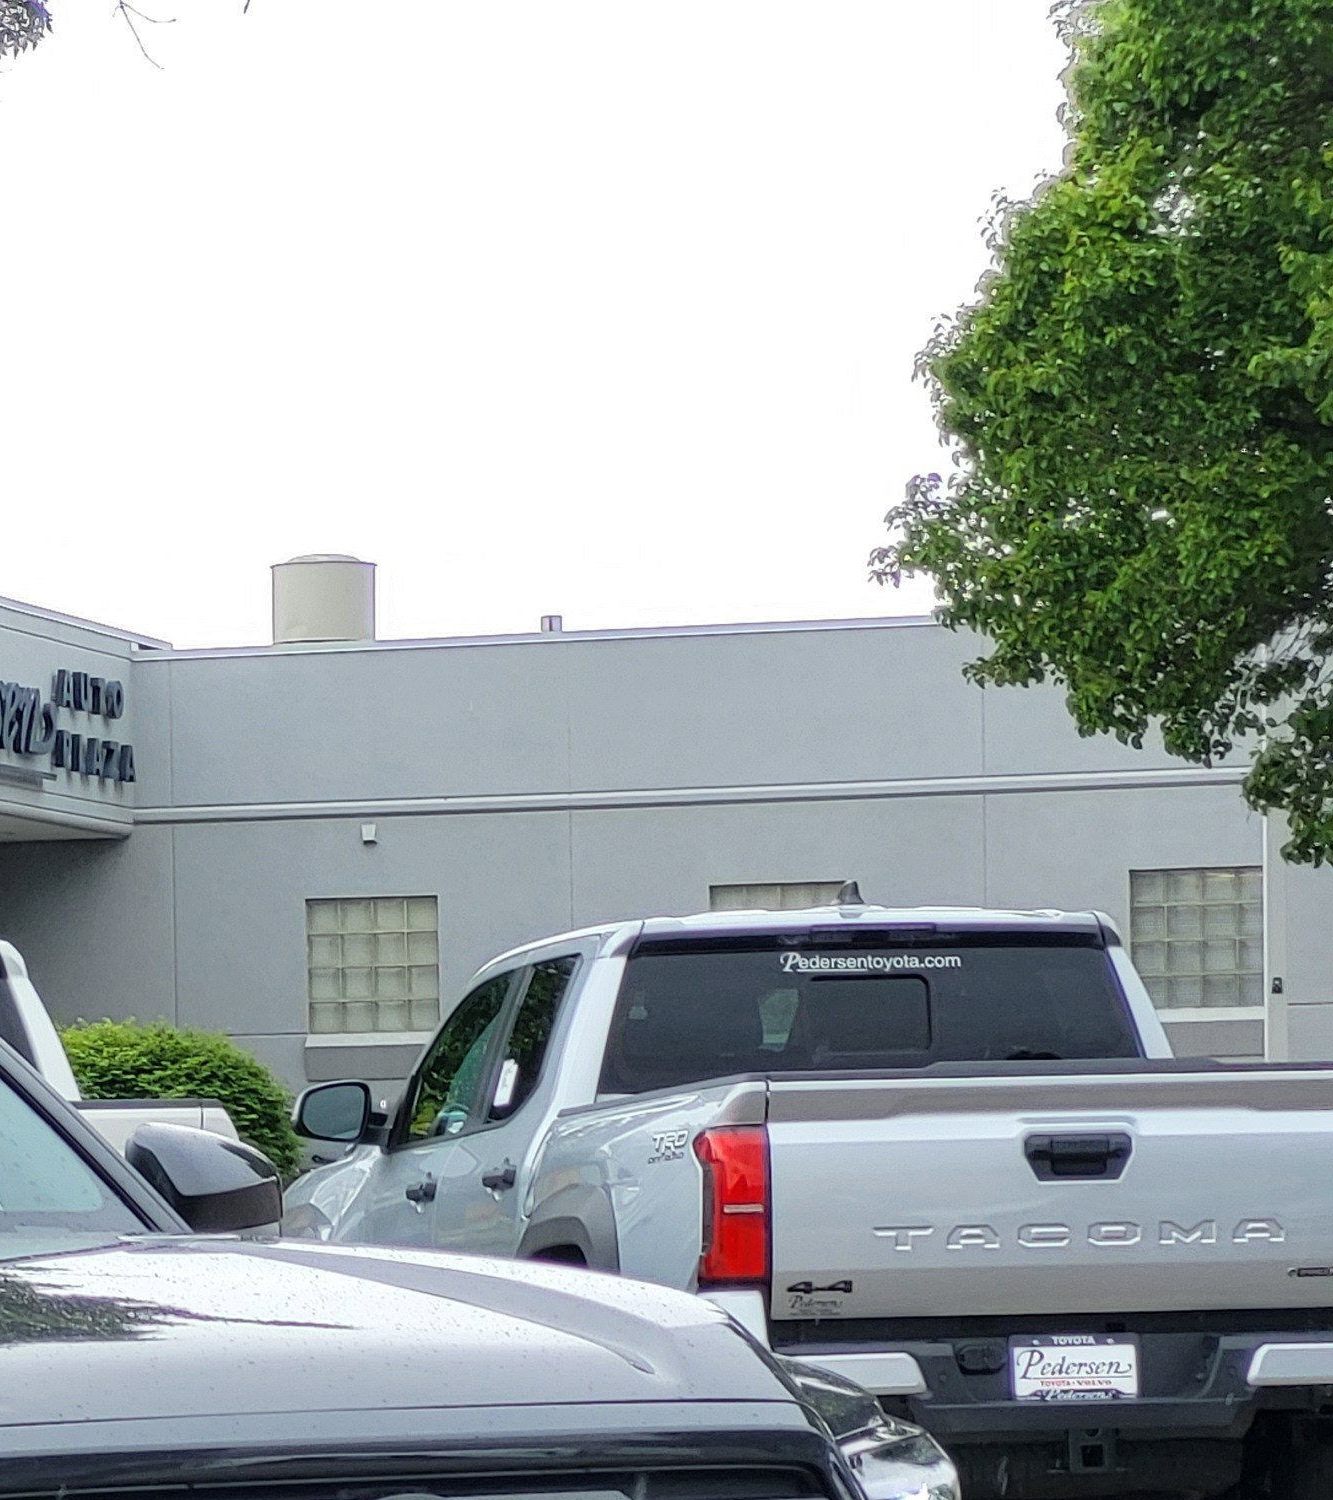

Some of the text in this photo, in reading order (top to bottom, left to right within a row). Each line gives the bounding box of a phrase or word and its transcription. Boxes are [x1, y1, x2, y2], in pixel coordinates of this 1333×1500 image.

[52, 668, 125, 719] AUTO
[50, 729, 137, 782] PLAZA
[779, 951, 962, 972] Pedersentoyota.com
[652, 1130, 689, 1154] TRD
[872, 1218, 1286, 1252] TACOMA
[1052, 1335, 1096, 1345] TOYOTA
[1016, 1349, 1132, 1379] Pedersen
